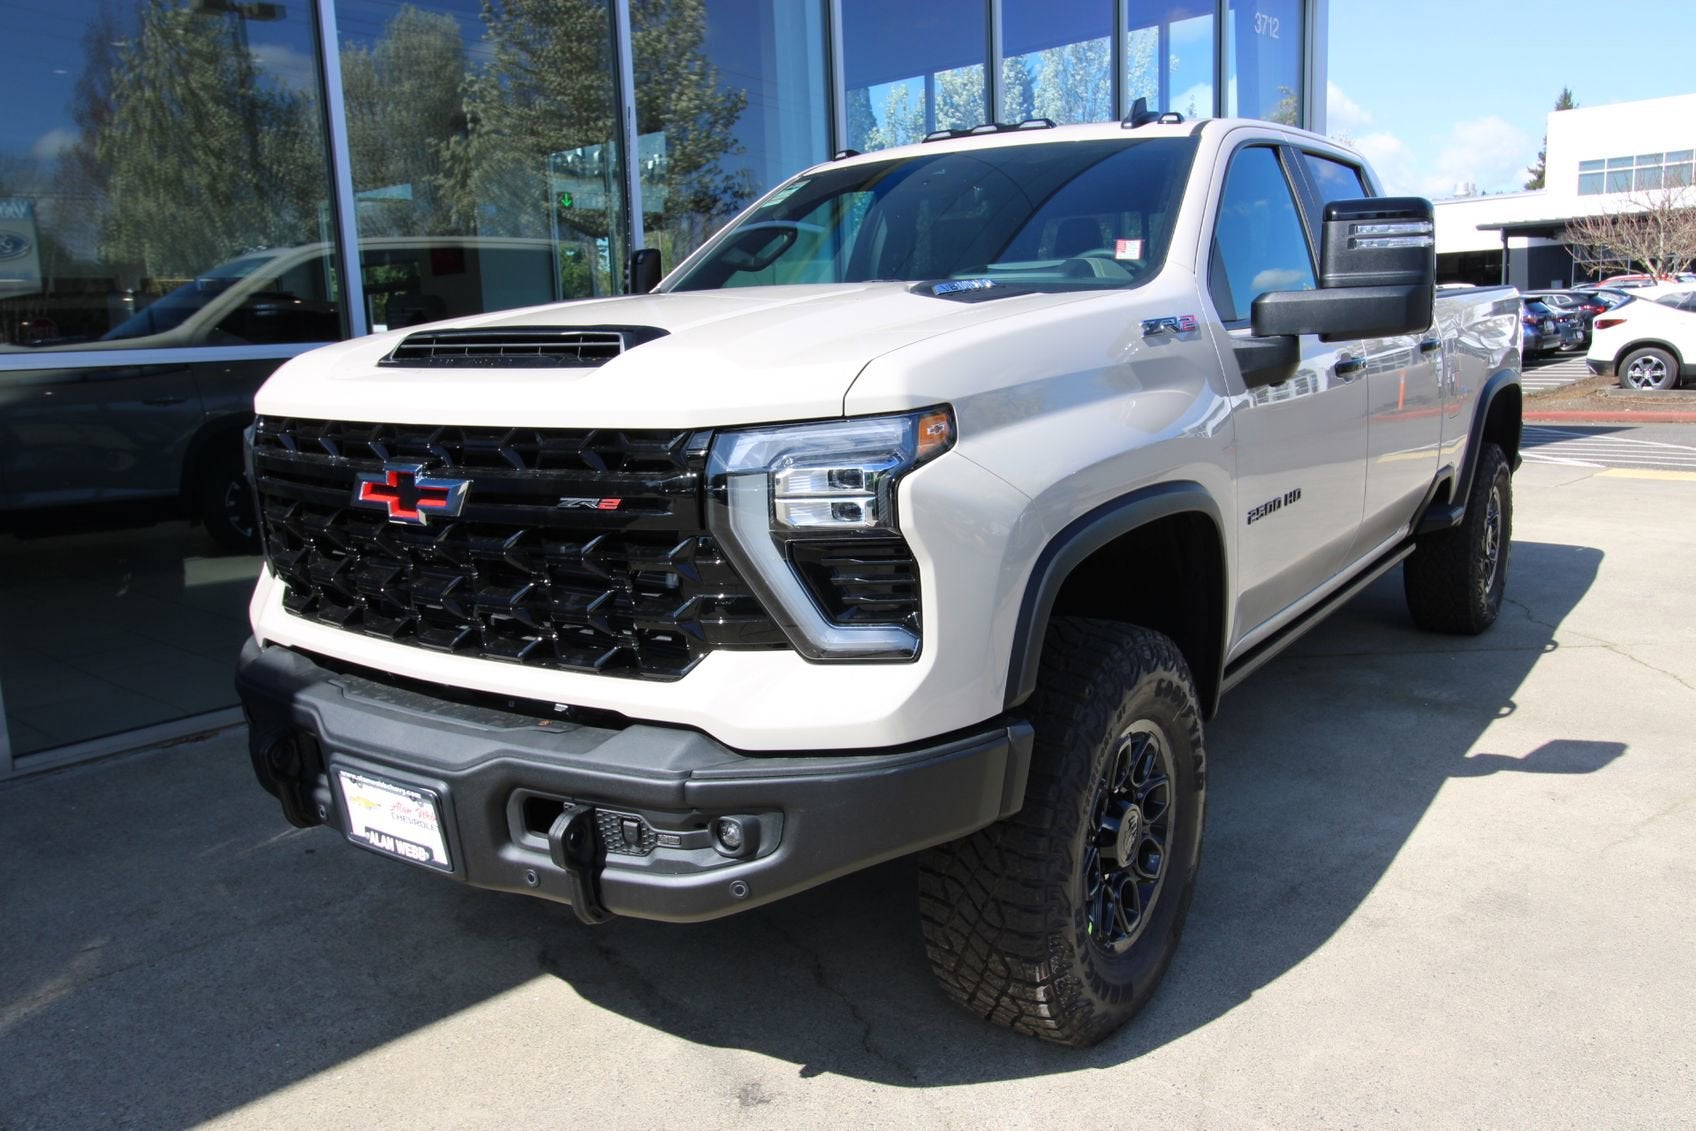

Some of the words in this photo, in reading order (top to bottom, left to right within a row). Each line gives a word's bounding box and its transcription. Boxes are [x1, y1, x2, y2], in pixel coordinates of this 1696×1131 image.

[1254, 11, 1280, 39] 3712
[1140, 315, 1197, 336] ZR2
[557, 497, 622, 510] ZR2
[1247, 496, 1281, 526] 2500
[1284, 487, 1302, 507] HD
[369, 831, 396, 853] ALAN
[395, 839, 427, 862] WEBB
